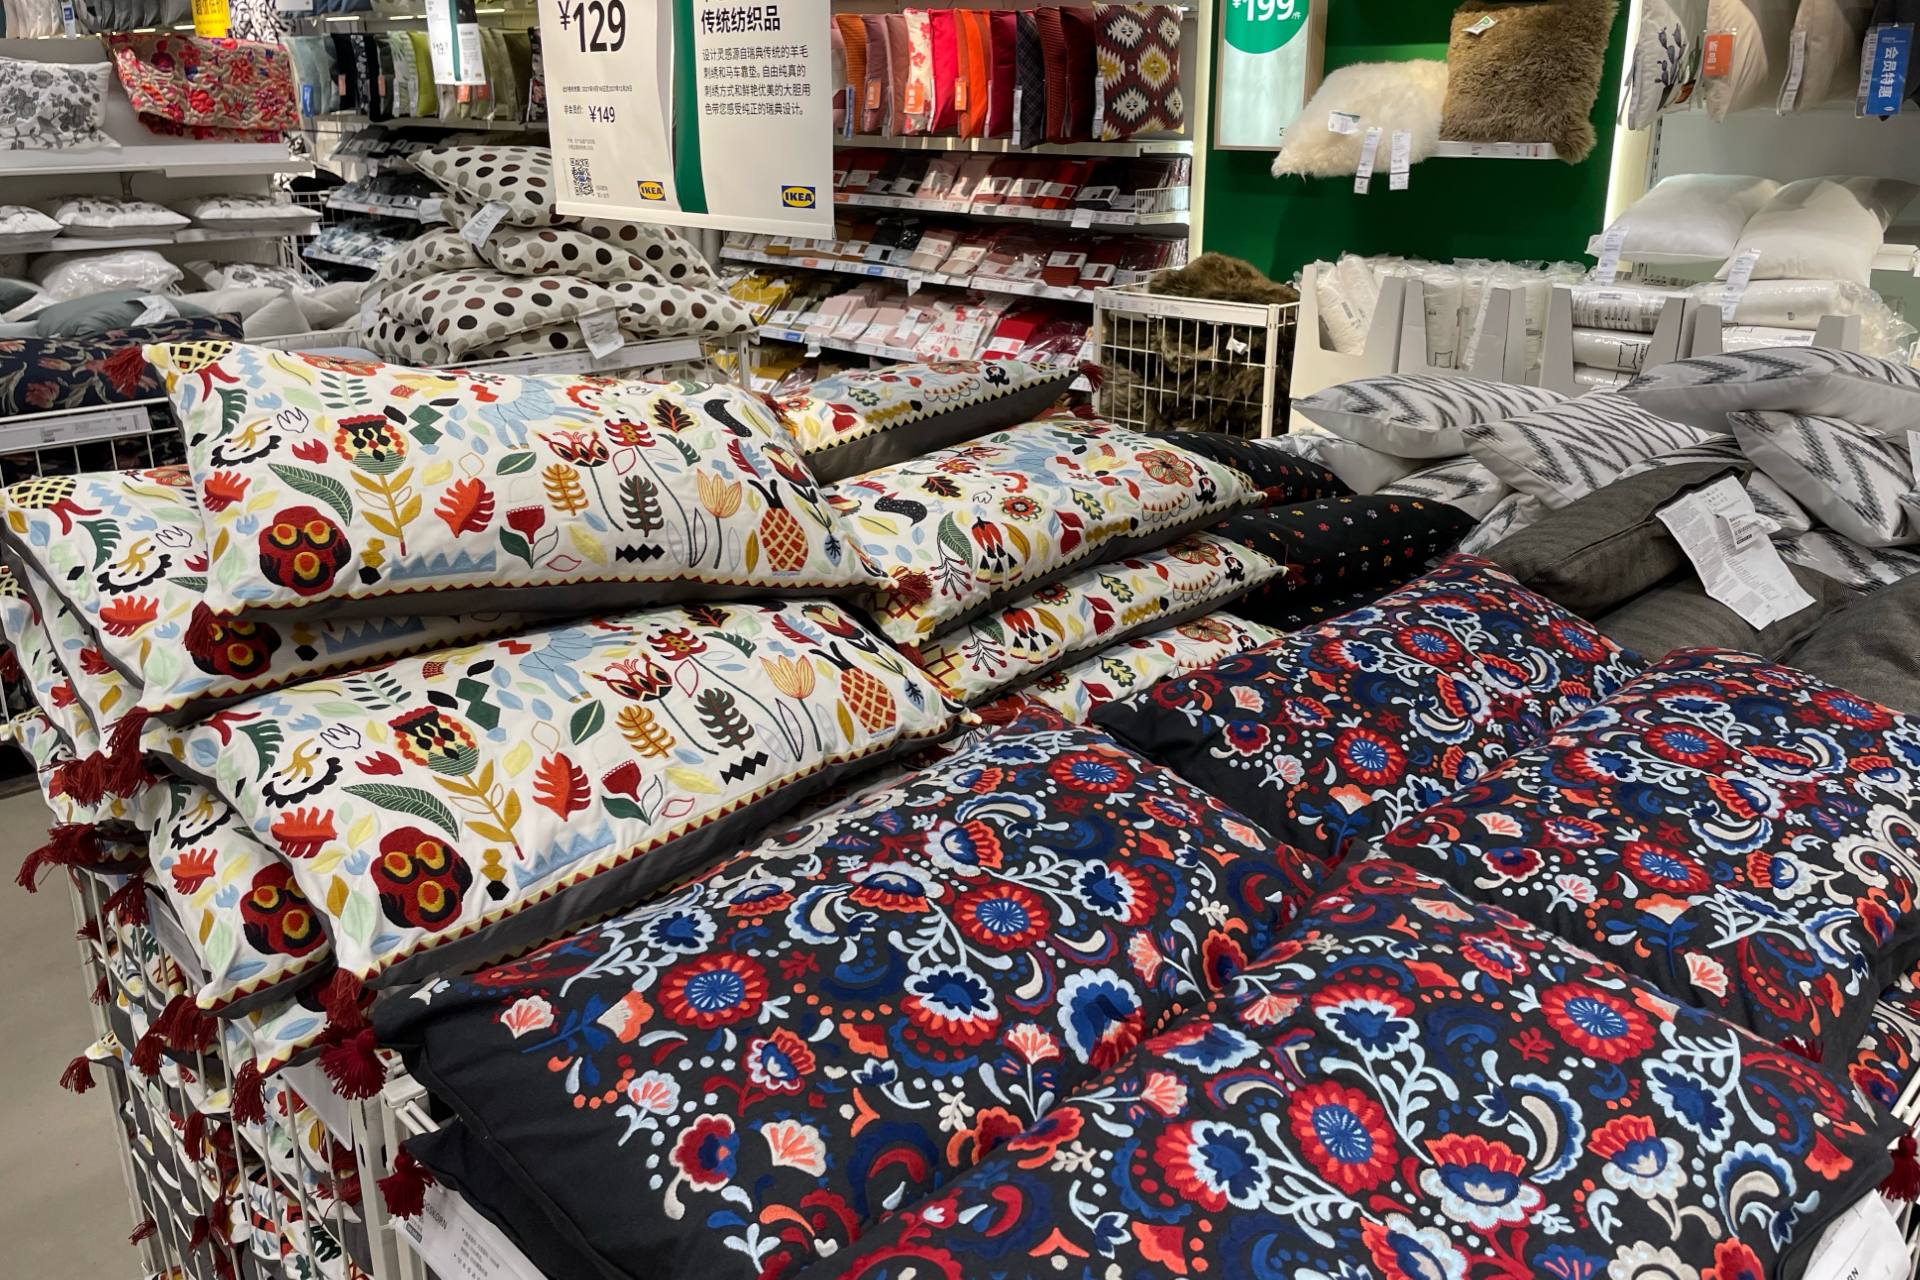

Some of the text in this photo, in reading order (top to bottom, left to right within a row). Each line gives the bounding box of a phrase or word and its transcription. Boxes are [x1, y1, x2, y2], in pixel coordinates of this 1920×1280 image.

[557, 0, 626, 53] ¥129
[701, 5, 781, 35] 传统纺织品
[702, 45, 809, 61] 设计灵感源自瑞典传统的羊毛
[1878, 46, 1899, 98] 会员特惠
[704, 83, 811, 98] 刺绣方式和鲜艳优美的大胆用
[588, 105, 616, 124] ¥149
[704, 101, 804, 116] 色带您感受纯正的瑞典设计。
[640, 186, 663, 196] IKEA
[784, 191, 813, 203] IKEA
